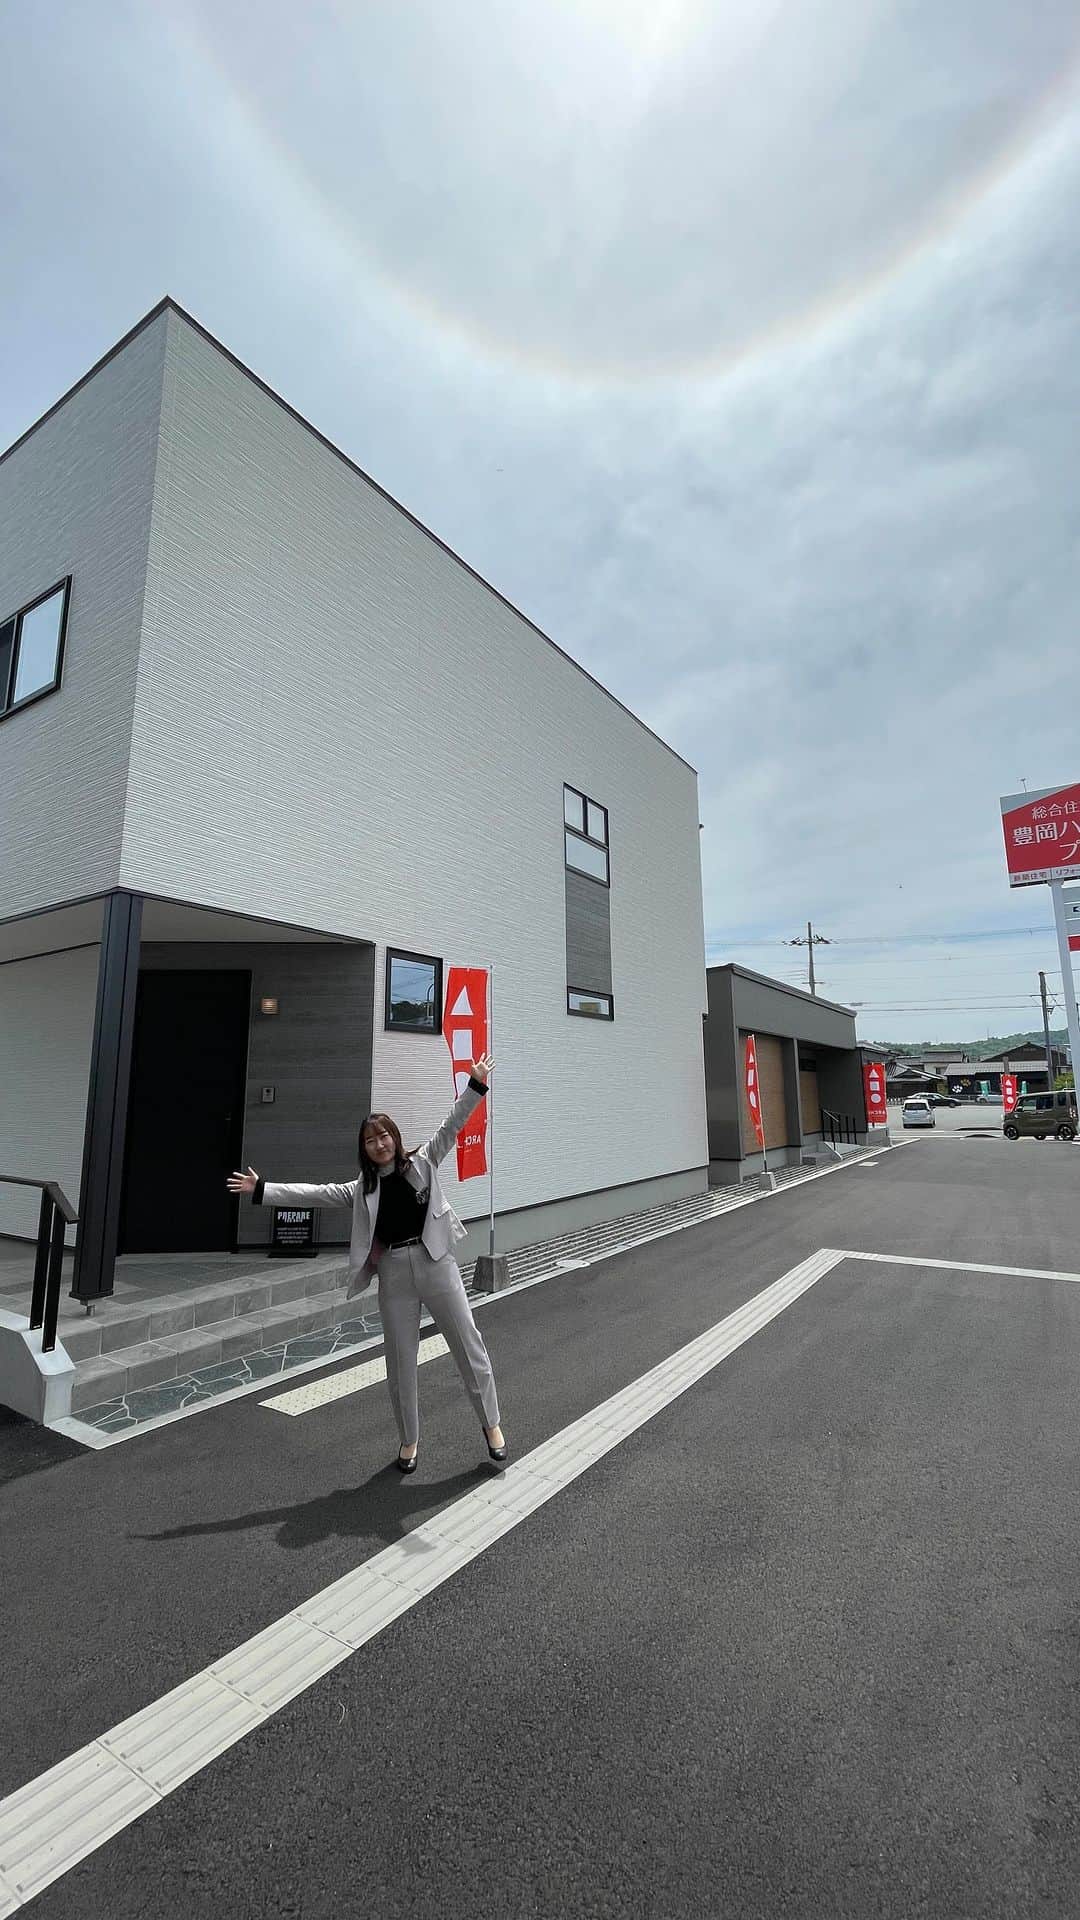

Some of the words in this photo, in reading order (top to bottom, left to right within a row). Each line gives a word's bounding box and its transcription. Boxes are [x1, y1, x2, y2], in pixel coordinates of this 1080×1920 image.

[1012, 820, 1080, 846] 豊岡ハ
[277, 1211, 310, 1220] PREPARE
